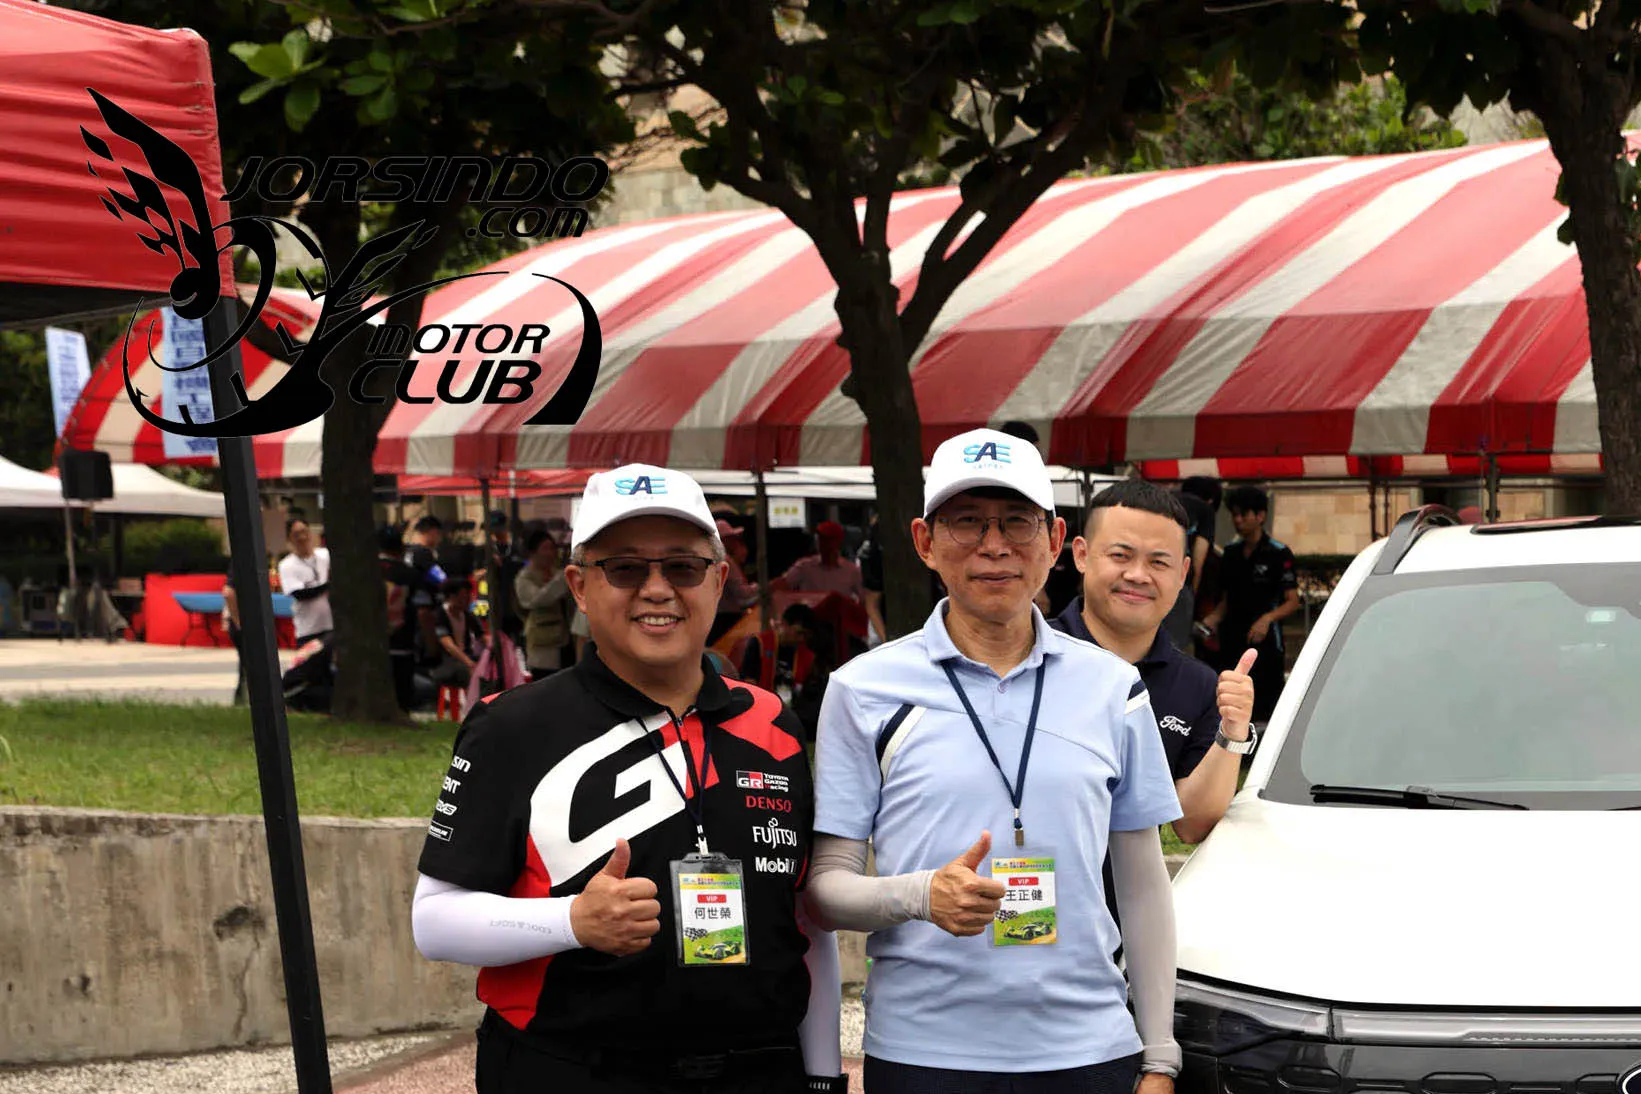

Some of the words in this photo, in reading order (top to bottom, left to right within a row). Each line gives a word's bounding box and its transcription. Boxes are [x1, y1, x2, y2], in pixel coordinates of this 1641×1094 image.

[963, 442, 1011, 463] SAE
[615, 475, 668, 495] SAE
[1160, 716, 1191, 737] Ford
[738, 777, 762, 788] GR
[745, 795, 792, 813] DENSO
[752, 819, 797, 849] FUJITSU
[1005, 889, 1043, 901] 王正健
[694, 907, 731, 919] 何世榮
